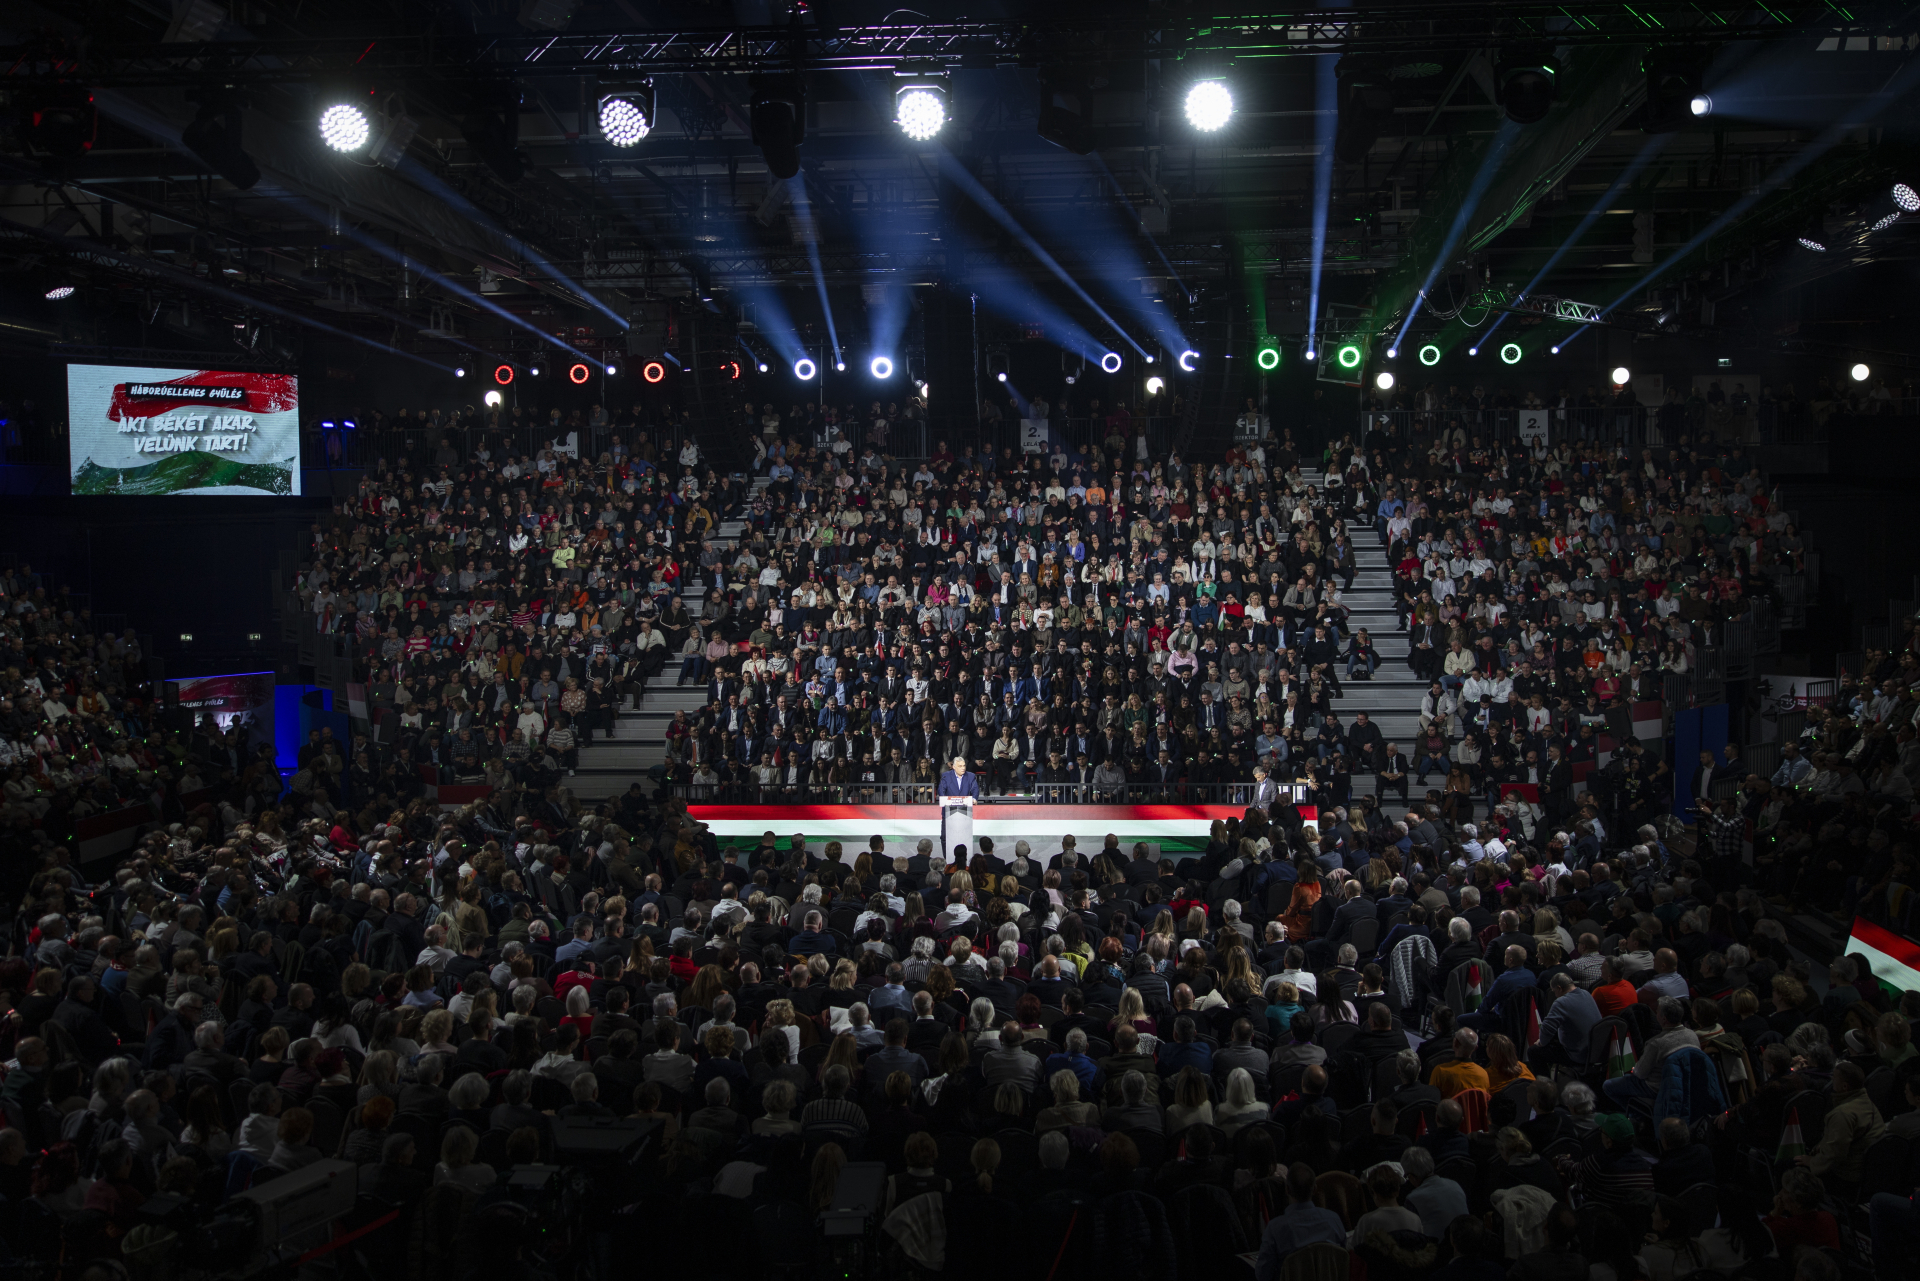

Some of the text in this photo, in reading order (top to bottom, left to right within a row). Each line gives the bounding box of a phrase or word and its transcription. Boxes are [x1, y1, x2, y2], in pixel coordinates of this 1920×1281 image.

[131, 384, 206, 397] HÁBORÚELLENES
[117, 413, 257, 433] AKI BÉKÉT AKAR,
[1246, 417, 1259, 435] H
[1527, 418, 1541, 429] 2.
[1027, 426, 1041, 438] 2.
[133, 433, 248, 453] VELÜNK TART!
